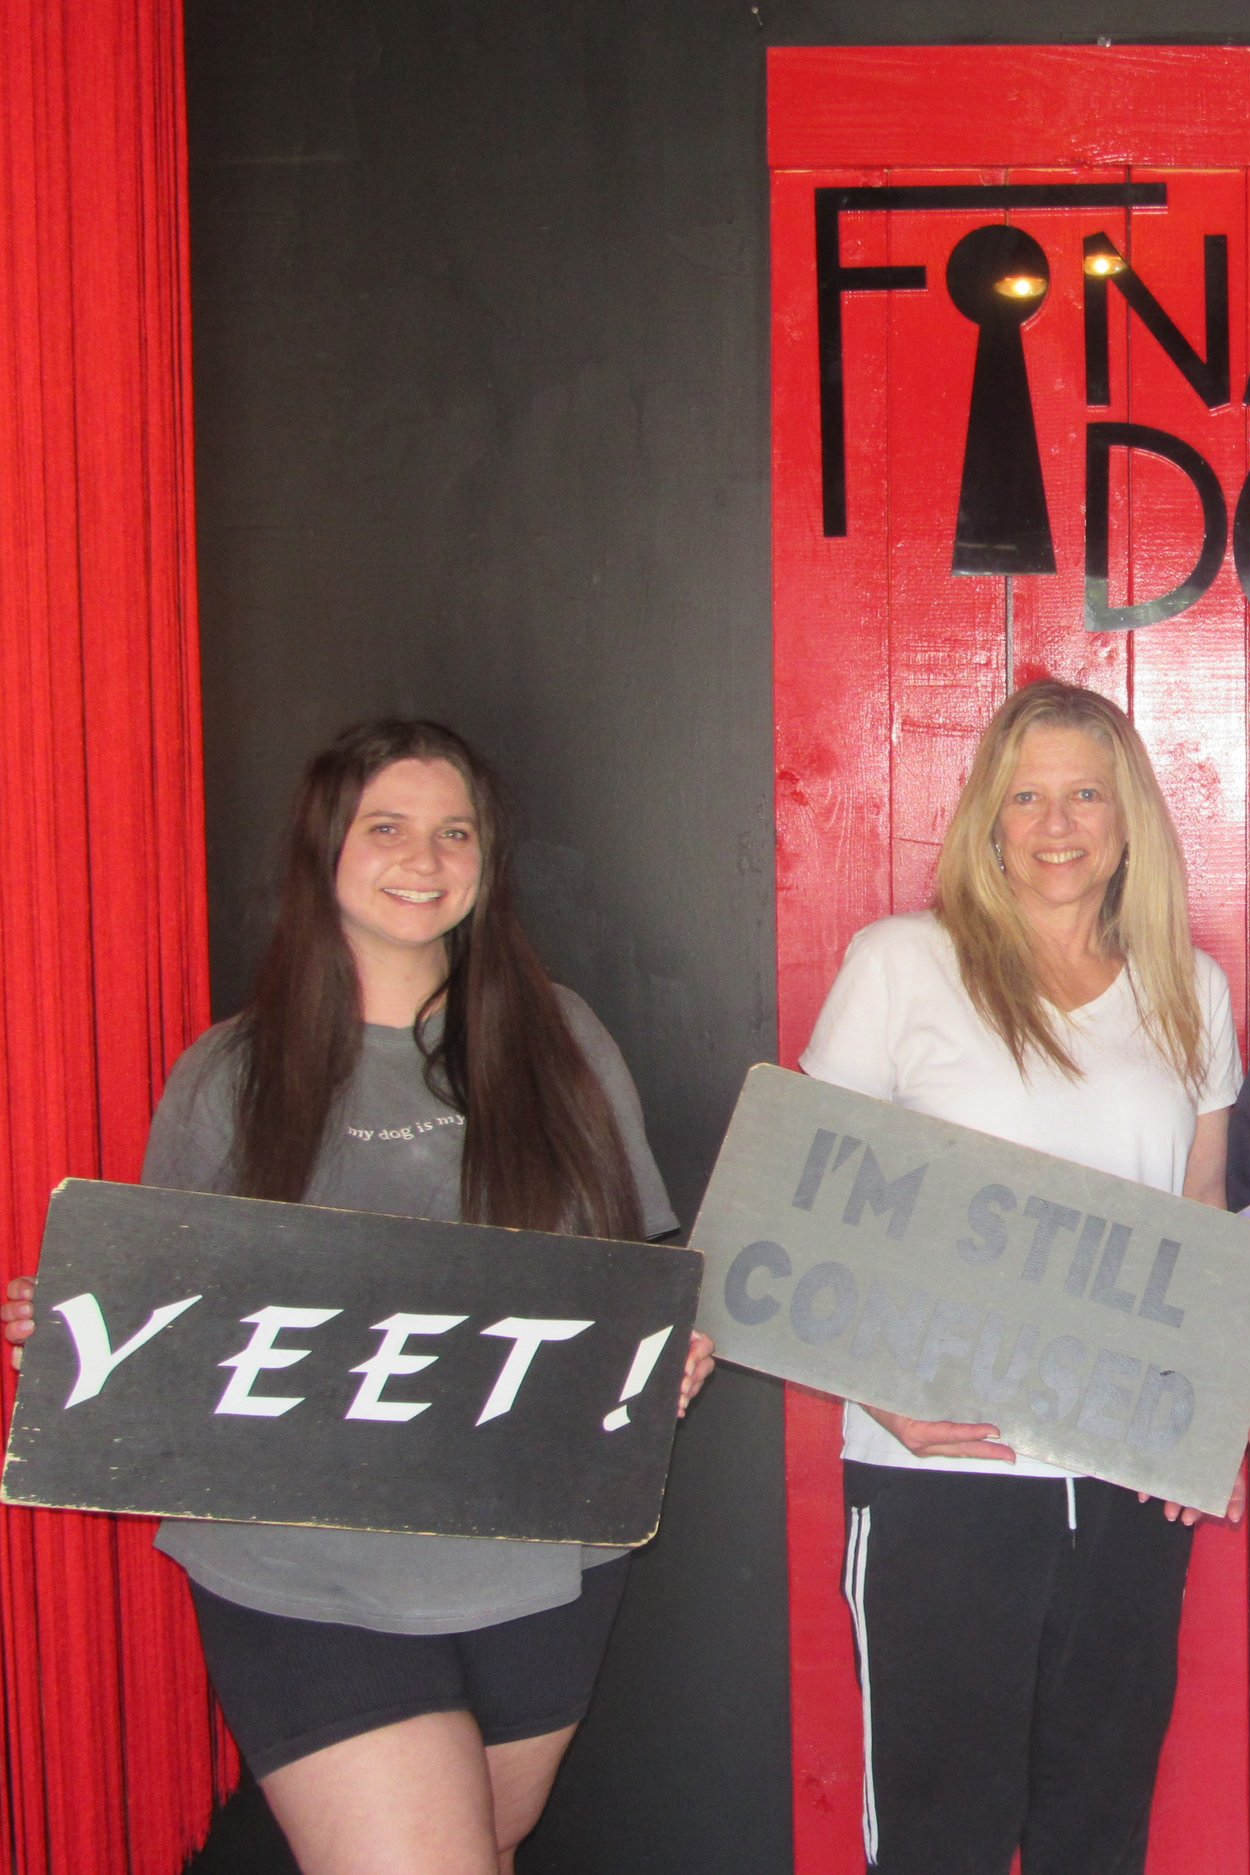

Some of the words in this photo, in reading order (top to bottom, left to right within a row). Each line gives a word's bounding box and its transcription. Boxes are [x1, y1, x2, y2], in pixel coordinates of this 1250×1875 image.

[348, 1126, 374, 1141] my
[378, 1125, 415, 1140] dog
[416, 1121, 433, 1133] is
[791, 1128, 929, 1241] I'M
[957, 1184, 1185, 1329] STILL
[52, 1292, 674, 1432] YEET!
[723, 1240, 1195, 1456] CONFUSED
